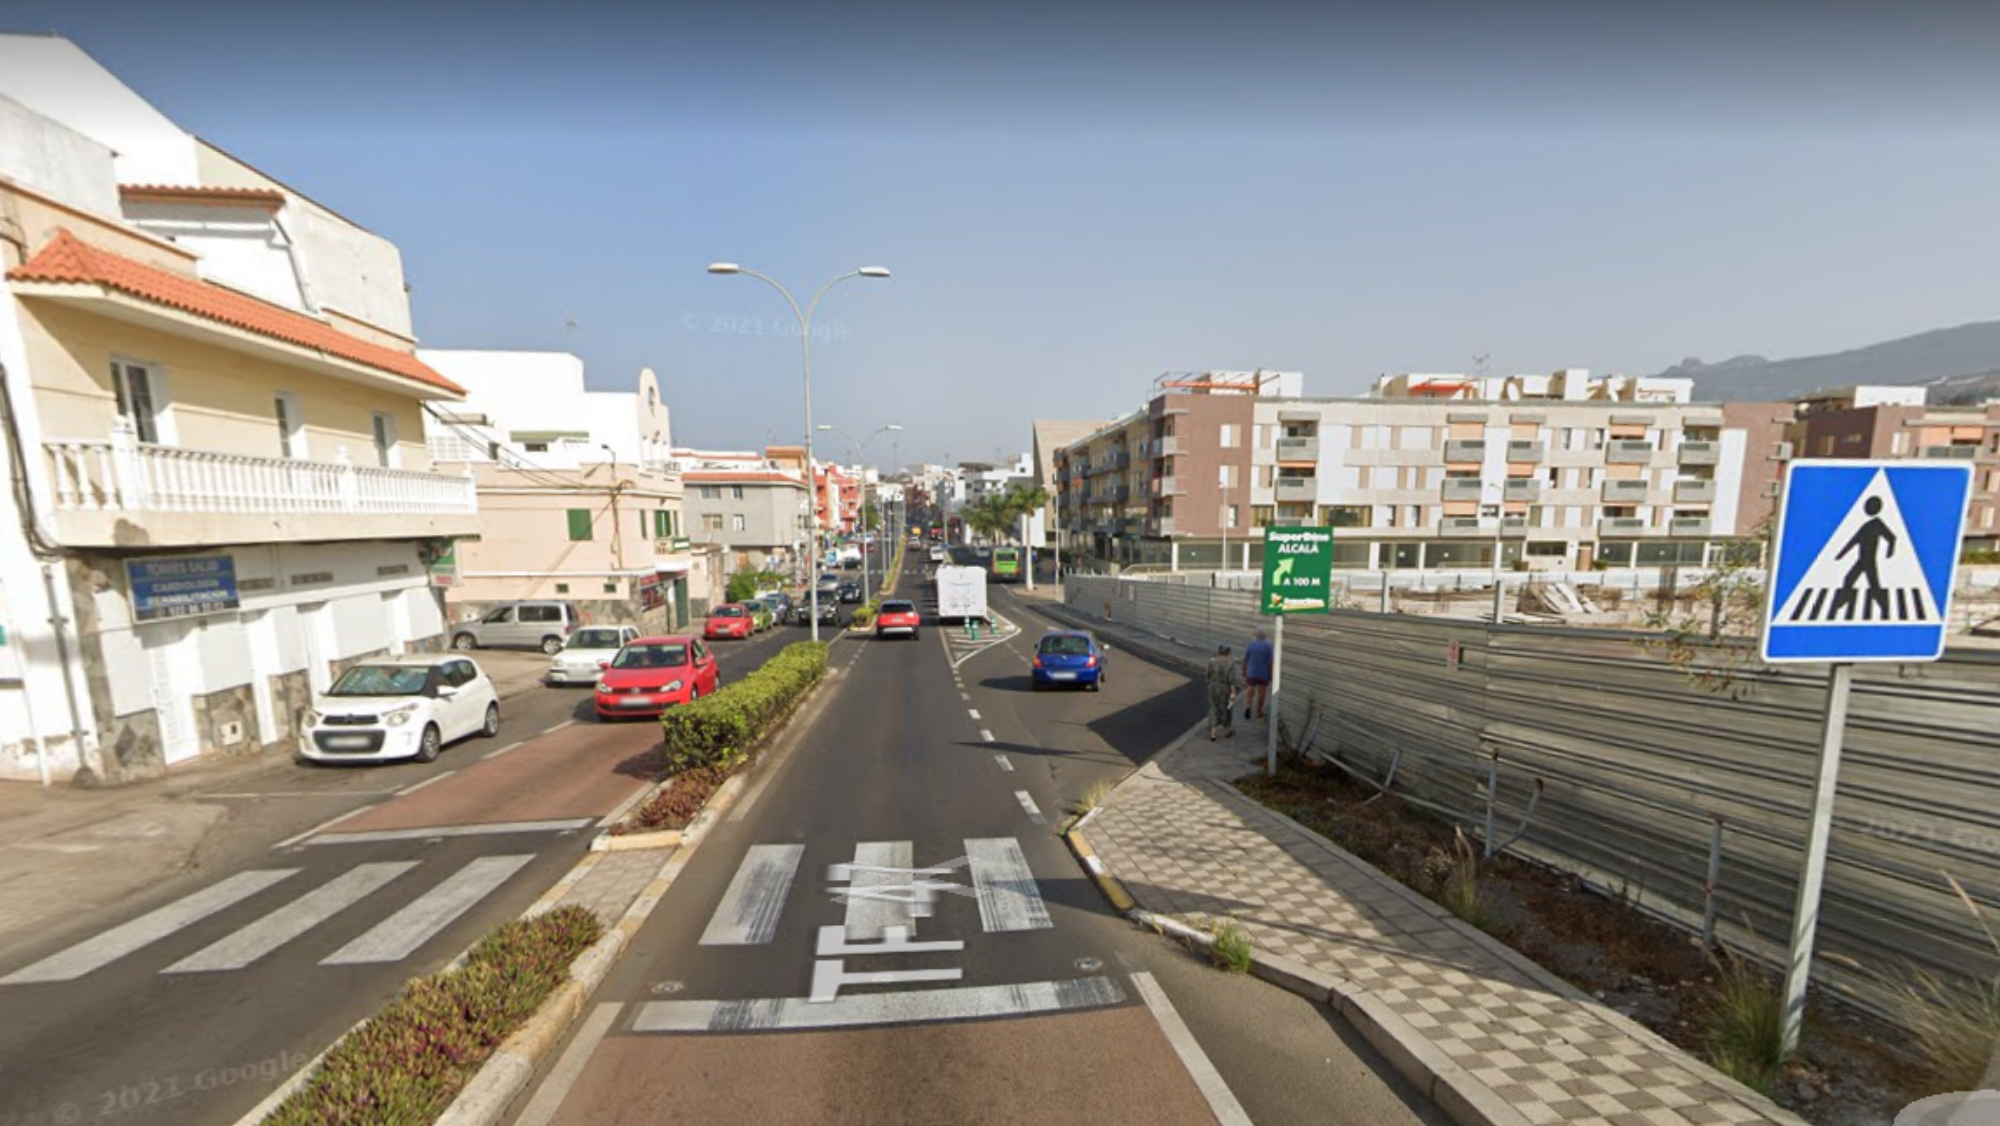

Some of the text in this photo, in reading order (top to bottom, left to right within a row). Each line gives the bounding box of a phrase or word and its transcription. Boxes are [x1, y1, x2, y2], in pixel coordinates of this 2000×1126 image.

[1282, 576, 1321, 587] A 100 M
